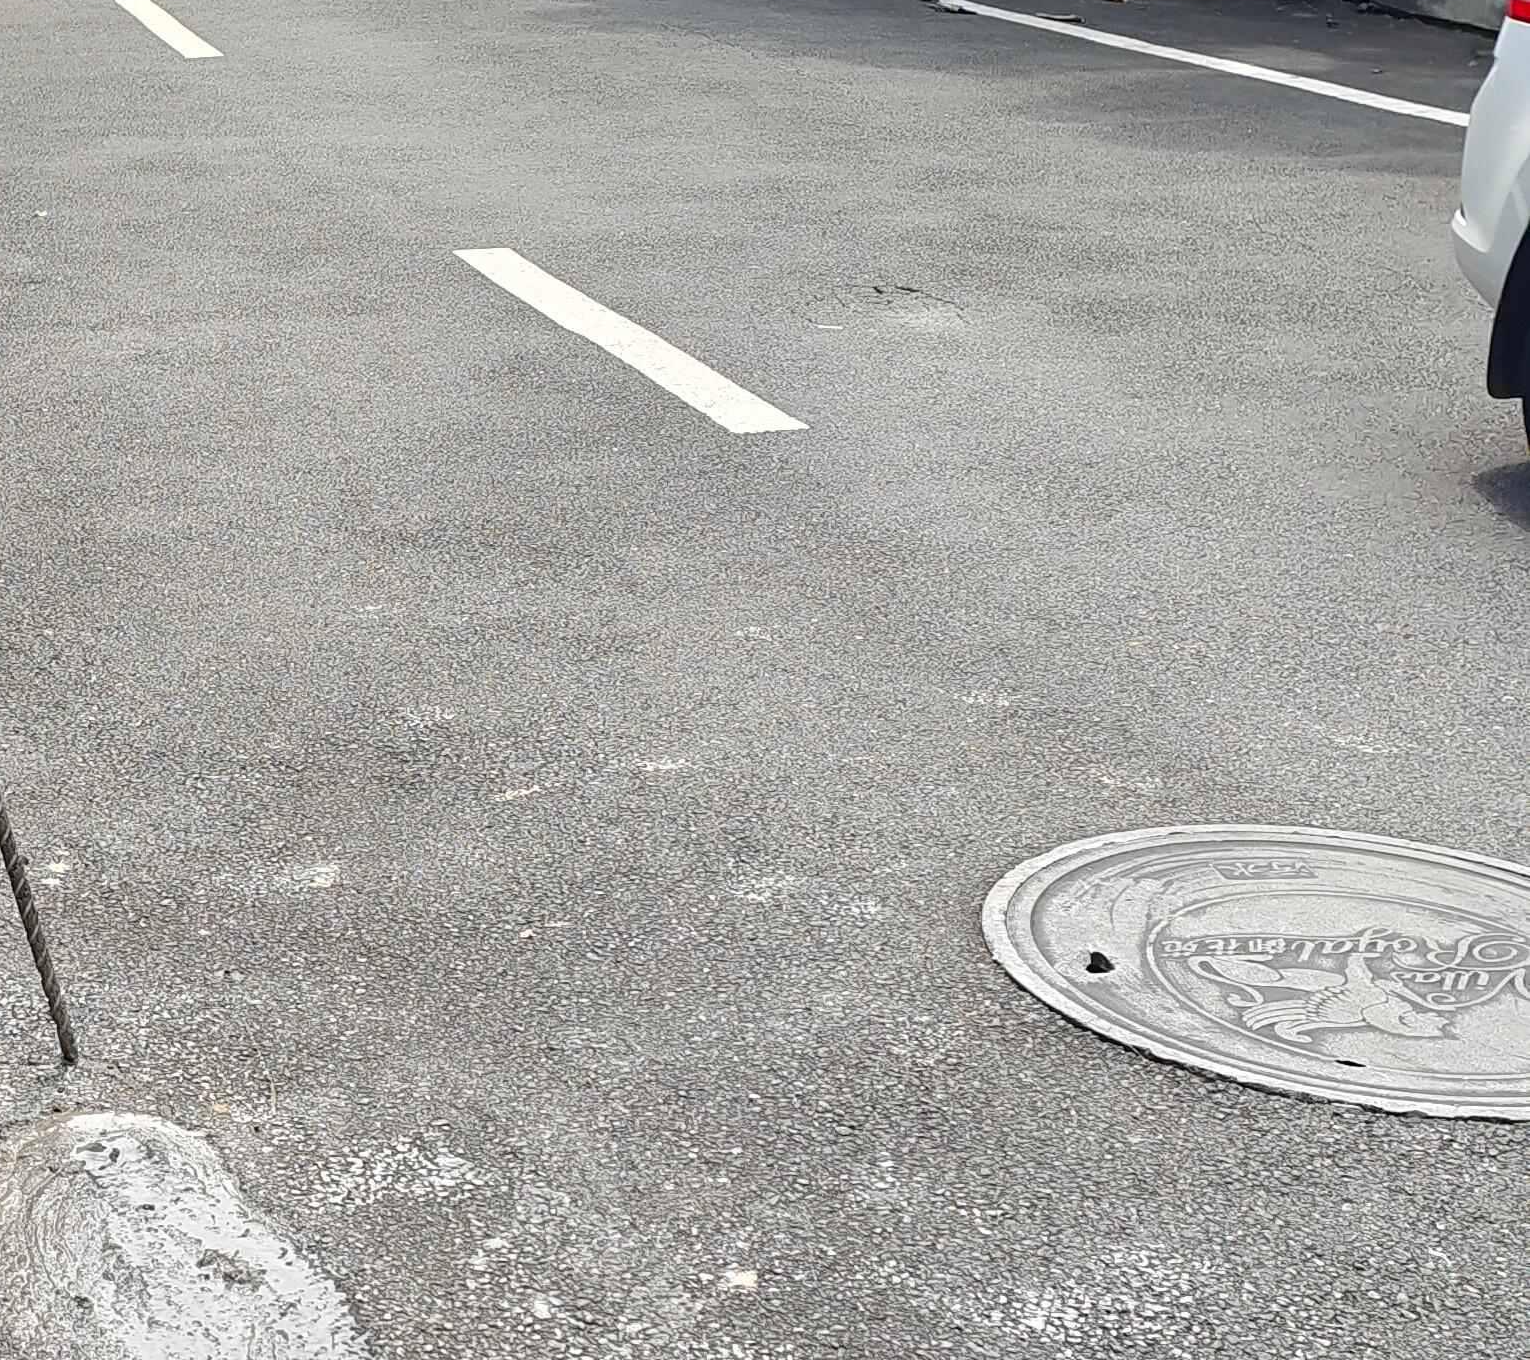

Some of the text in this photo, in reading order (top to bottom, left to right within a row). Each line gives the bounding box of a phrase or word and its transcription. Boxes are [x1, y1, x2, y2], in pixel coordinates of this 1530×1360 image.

[1161, 937, 1286, 957] 御花苑
[1291, 927, 1530, 971] Royal
[1382, 968, 1530, 1011] Villas
